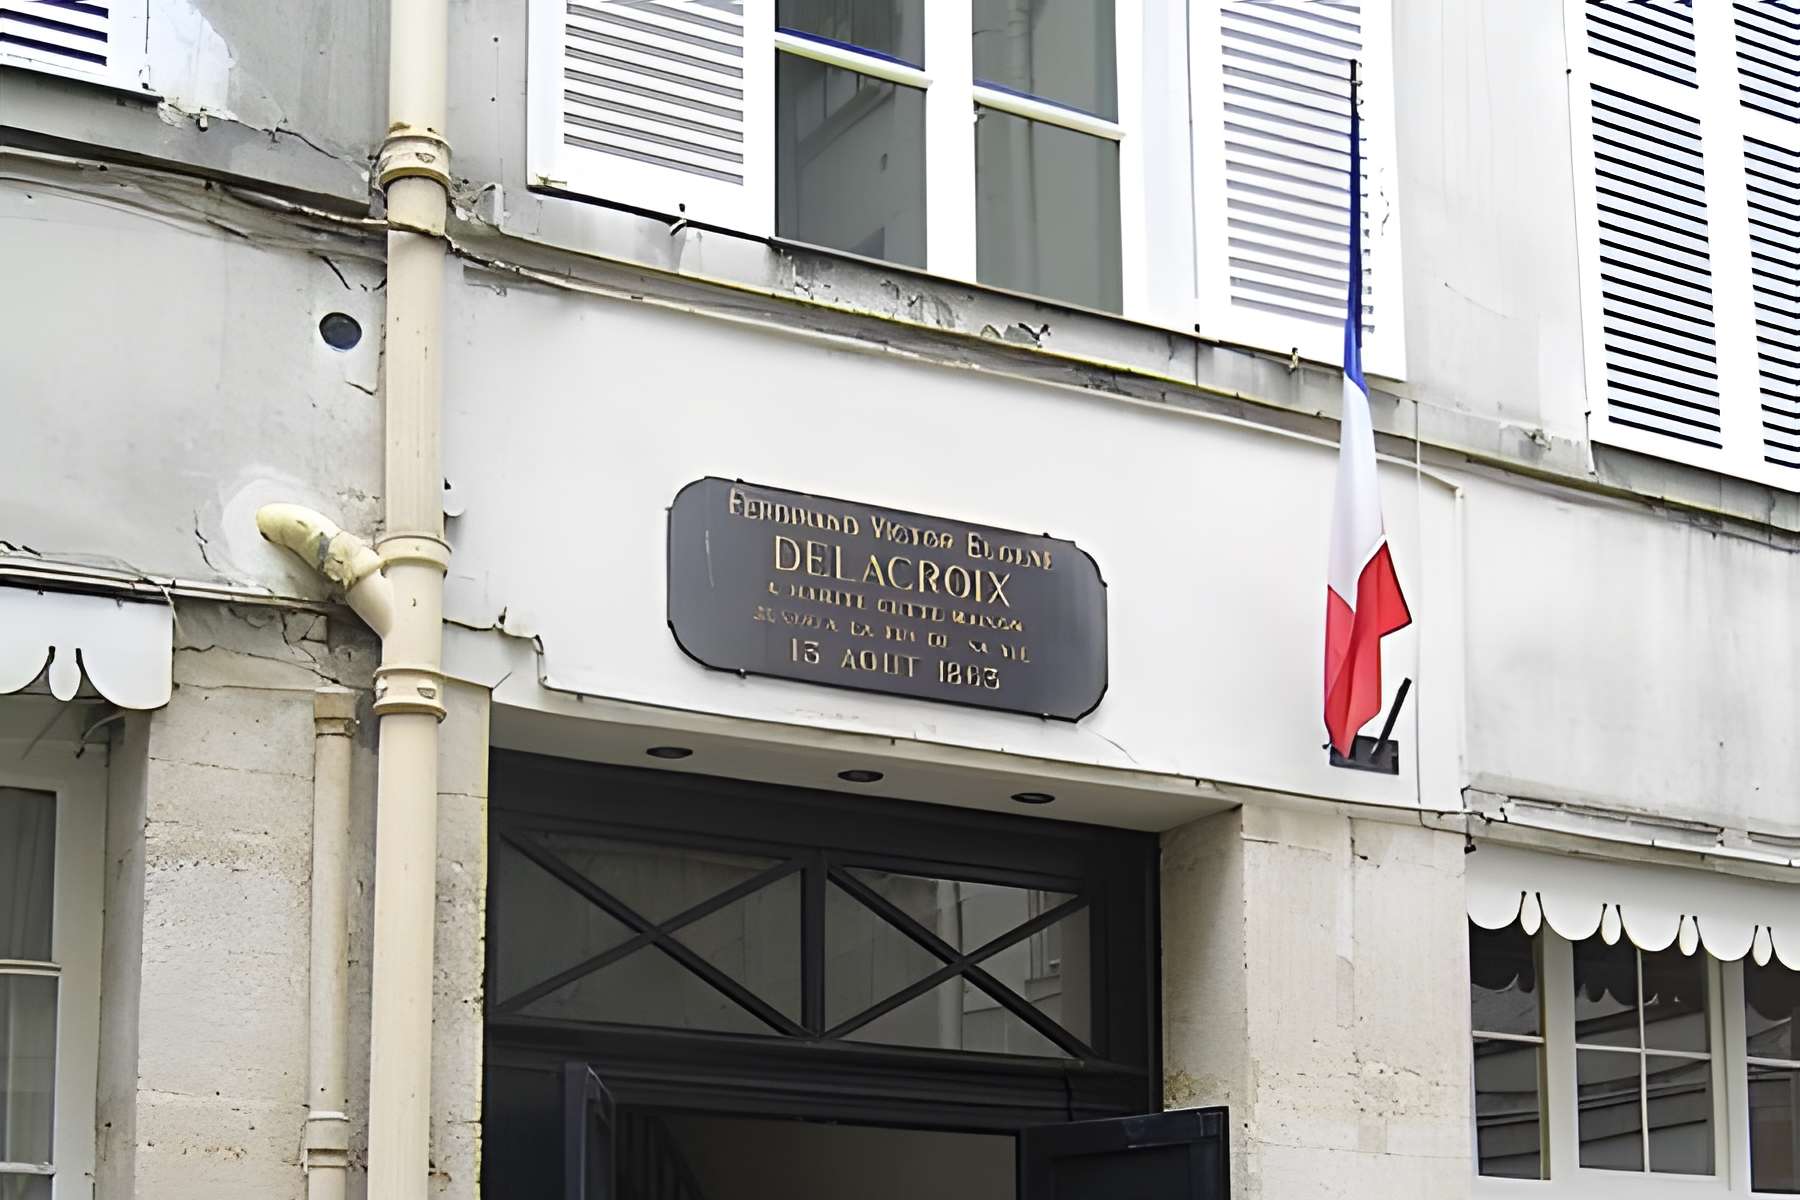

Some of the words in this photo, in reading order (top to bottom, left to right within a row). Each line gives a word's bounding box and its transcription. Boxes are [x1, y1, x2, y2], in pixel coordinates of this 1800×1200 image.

[775, 535, 1011, 608] DELACROIX
[840, 648, 921, 678] AOUT
[939, 659, 1000, 690] 1863
